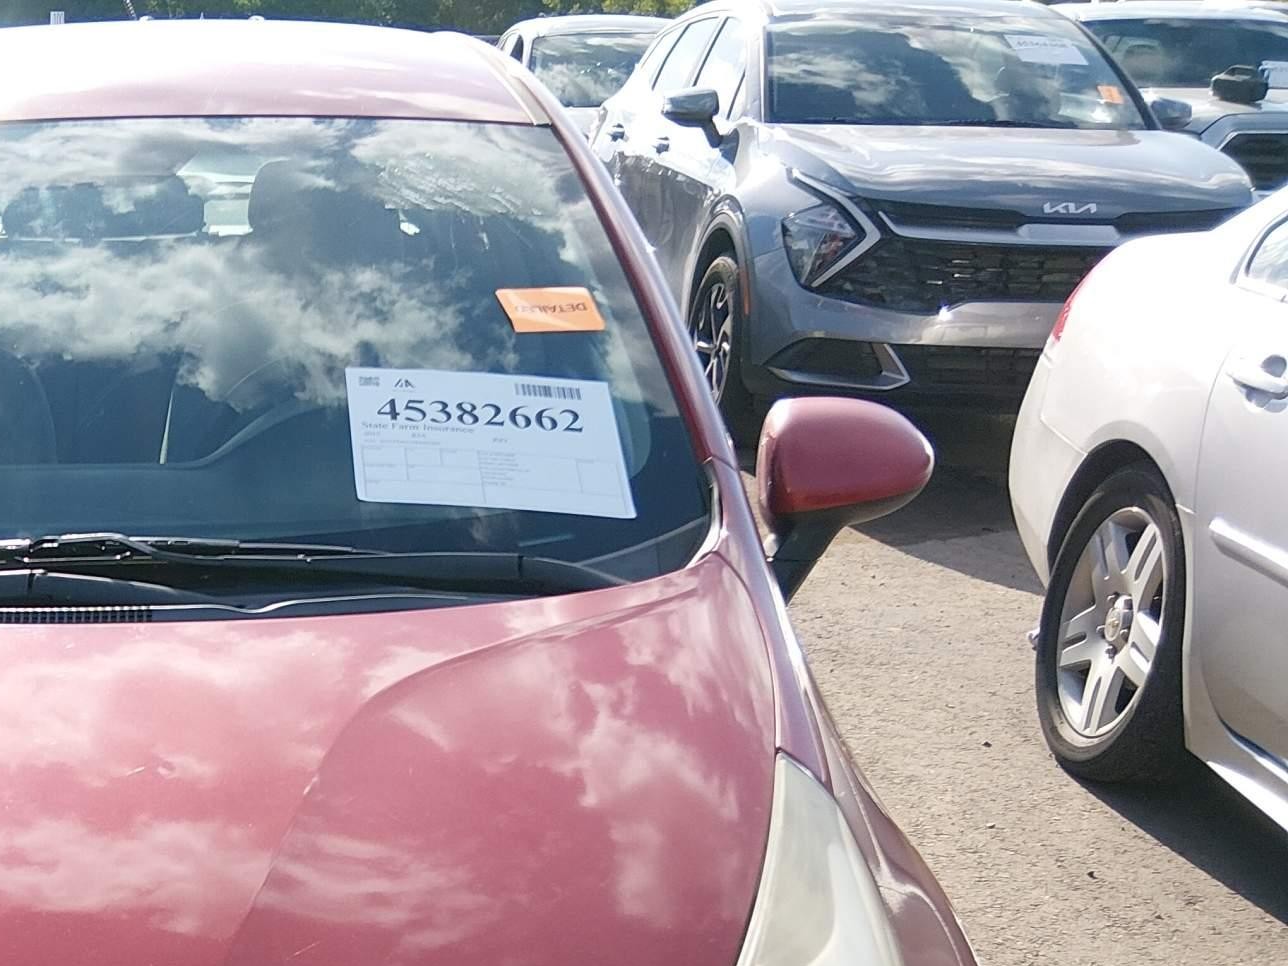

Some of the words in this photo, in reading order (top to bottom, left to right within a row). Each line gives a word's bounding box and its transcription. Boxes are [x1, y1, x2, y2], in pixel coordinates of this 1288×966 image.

[1043, 202, 1097, 214] KIA
[377, 398, 584, 433] 45382662
[361, 422, 388, 430] State
[391, 422, 419, 431] Farm
[423, 423, 475, 433] Insurance
